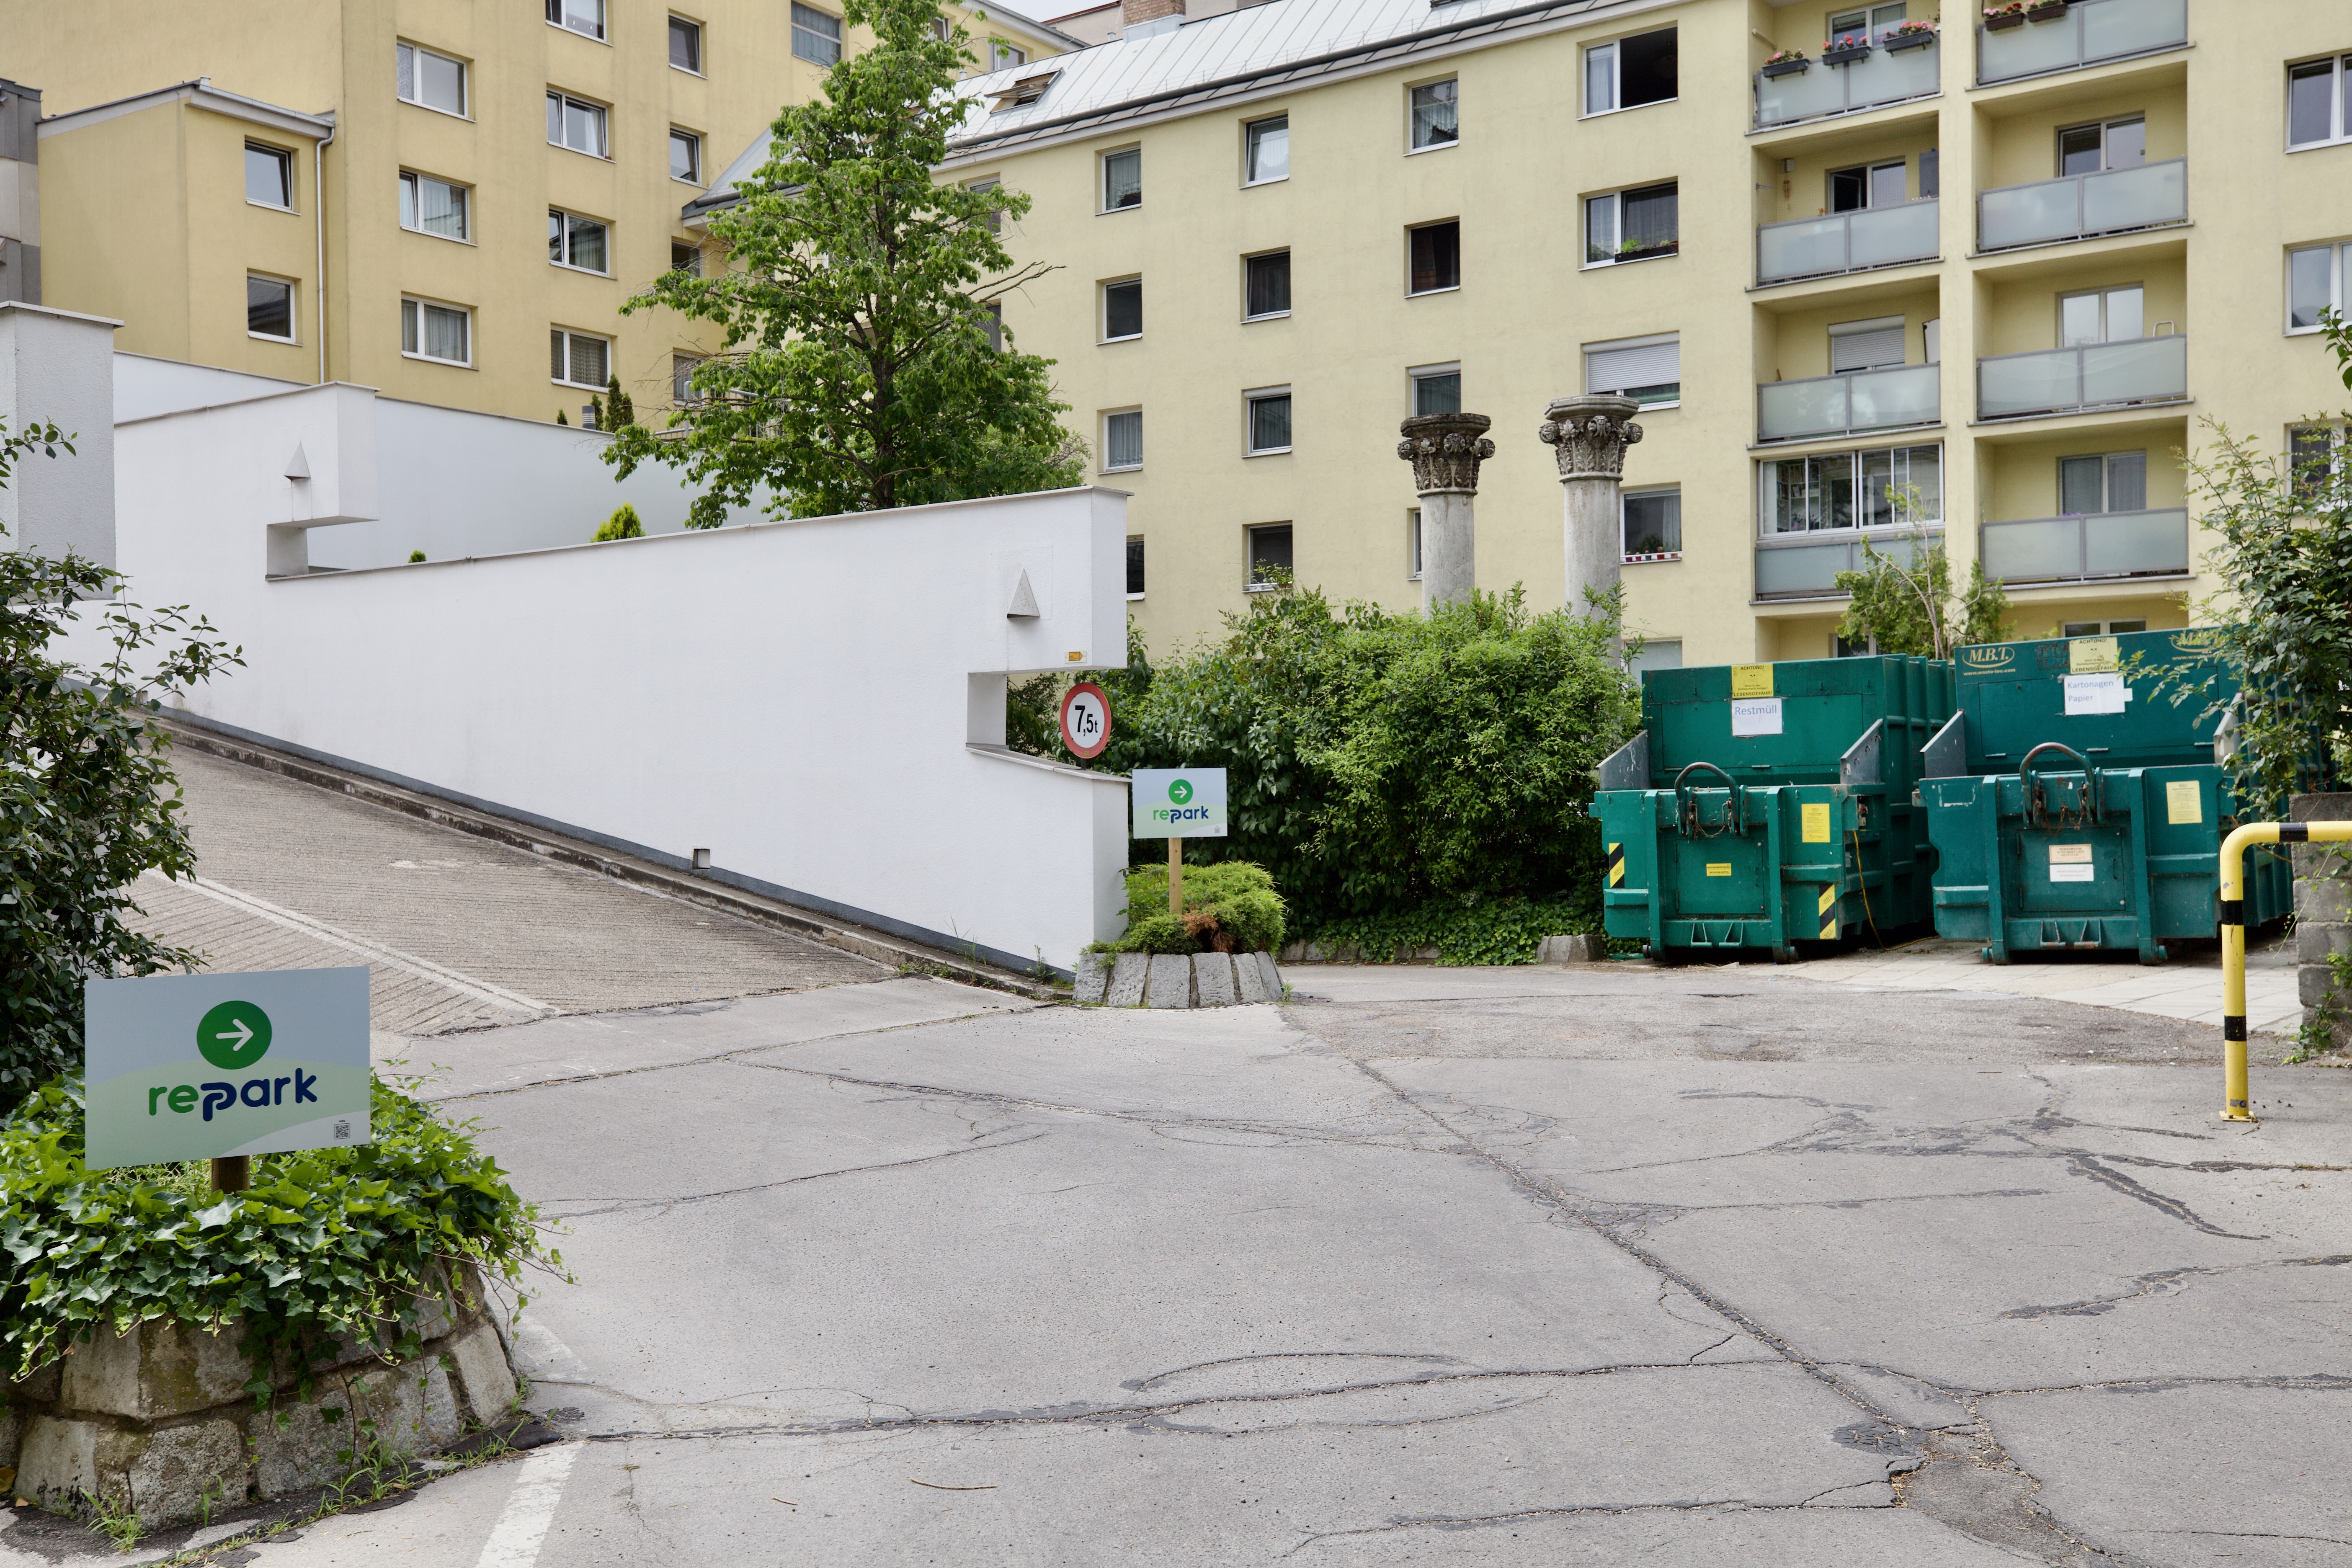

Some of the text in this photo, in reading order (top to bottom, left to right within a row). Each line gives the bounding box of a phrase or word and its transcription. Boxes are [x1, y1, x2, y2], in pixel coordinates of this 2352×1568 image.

[1969, 647, 2009, 663] M.B.T.
[2068, 695, 2093, 703] Papier
[1735, 704, 1777, 715] Restmüll
[1153, 805, 1209, 824] repark
[149, 1068, 317, 1122] repark
